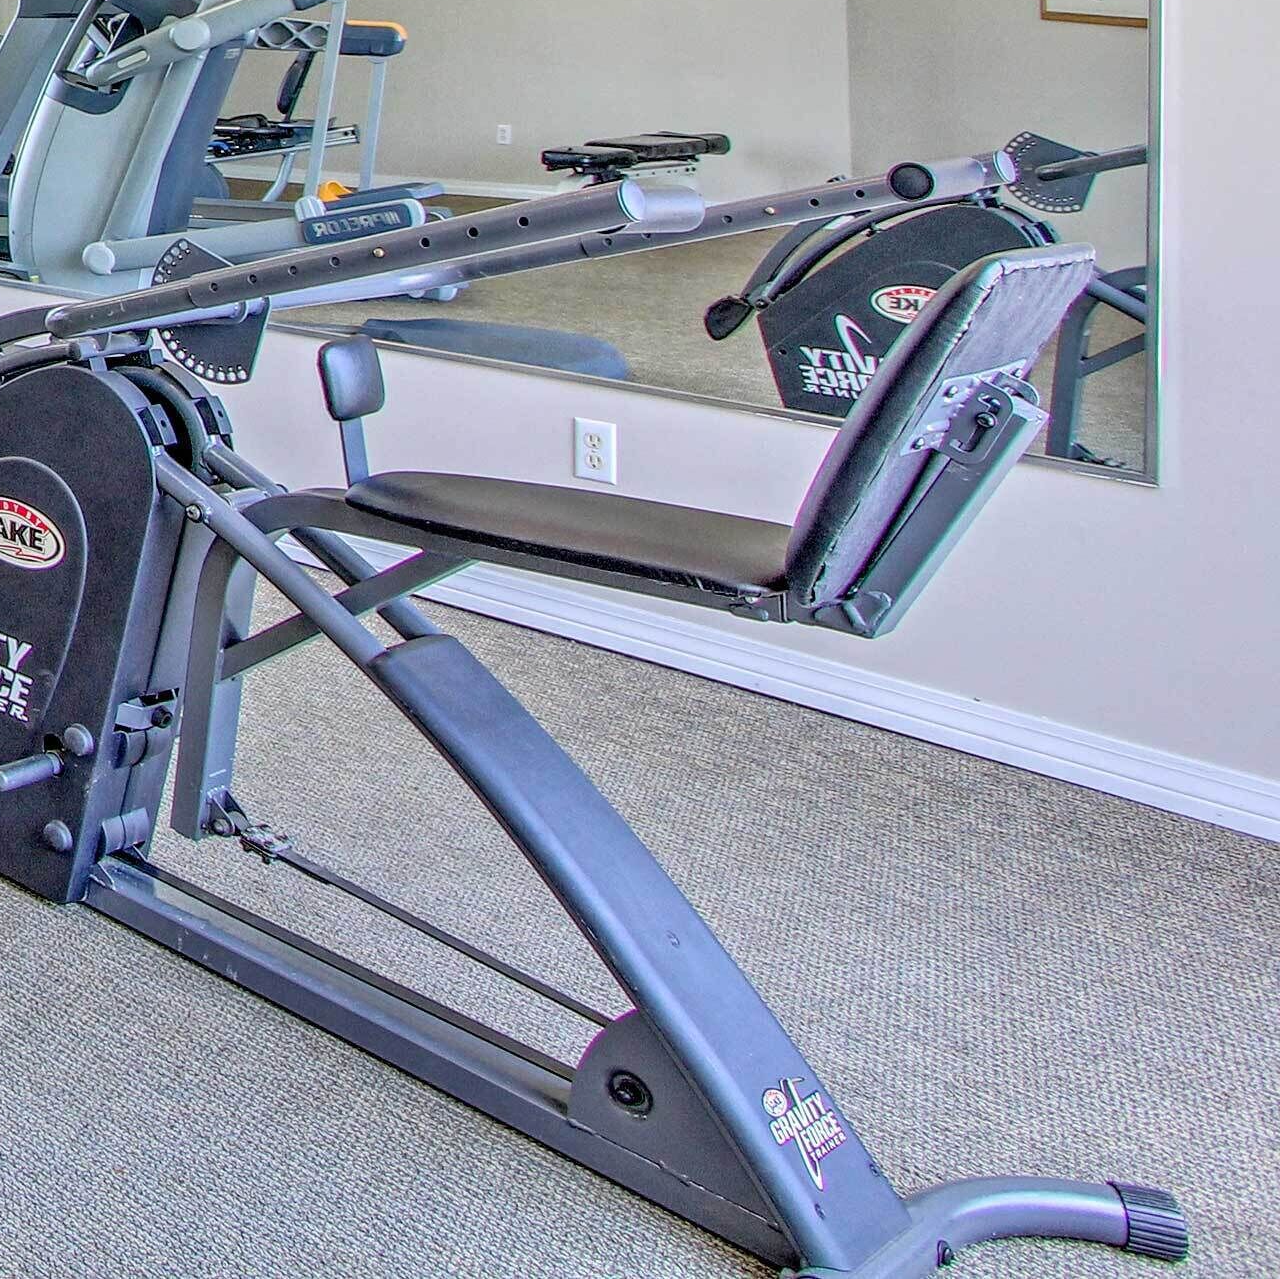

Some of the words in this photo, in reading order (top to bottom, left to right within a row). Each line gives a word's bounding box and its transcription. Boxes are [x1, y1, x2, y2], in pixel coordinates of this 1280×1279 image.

[25, 512, 42, 527] BY
[769, 1091, 827, 1145] GRAVITY
[800, 1111, 842, 1153] FORCE
[809, 1132, 847, 1162] TRAINER
